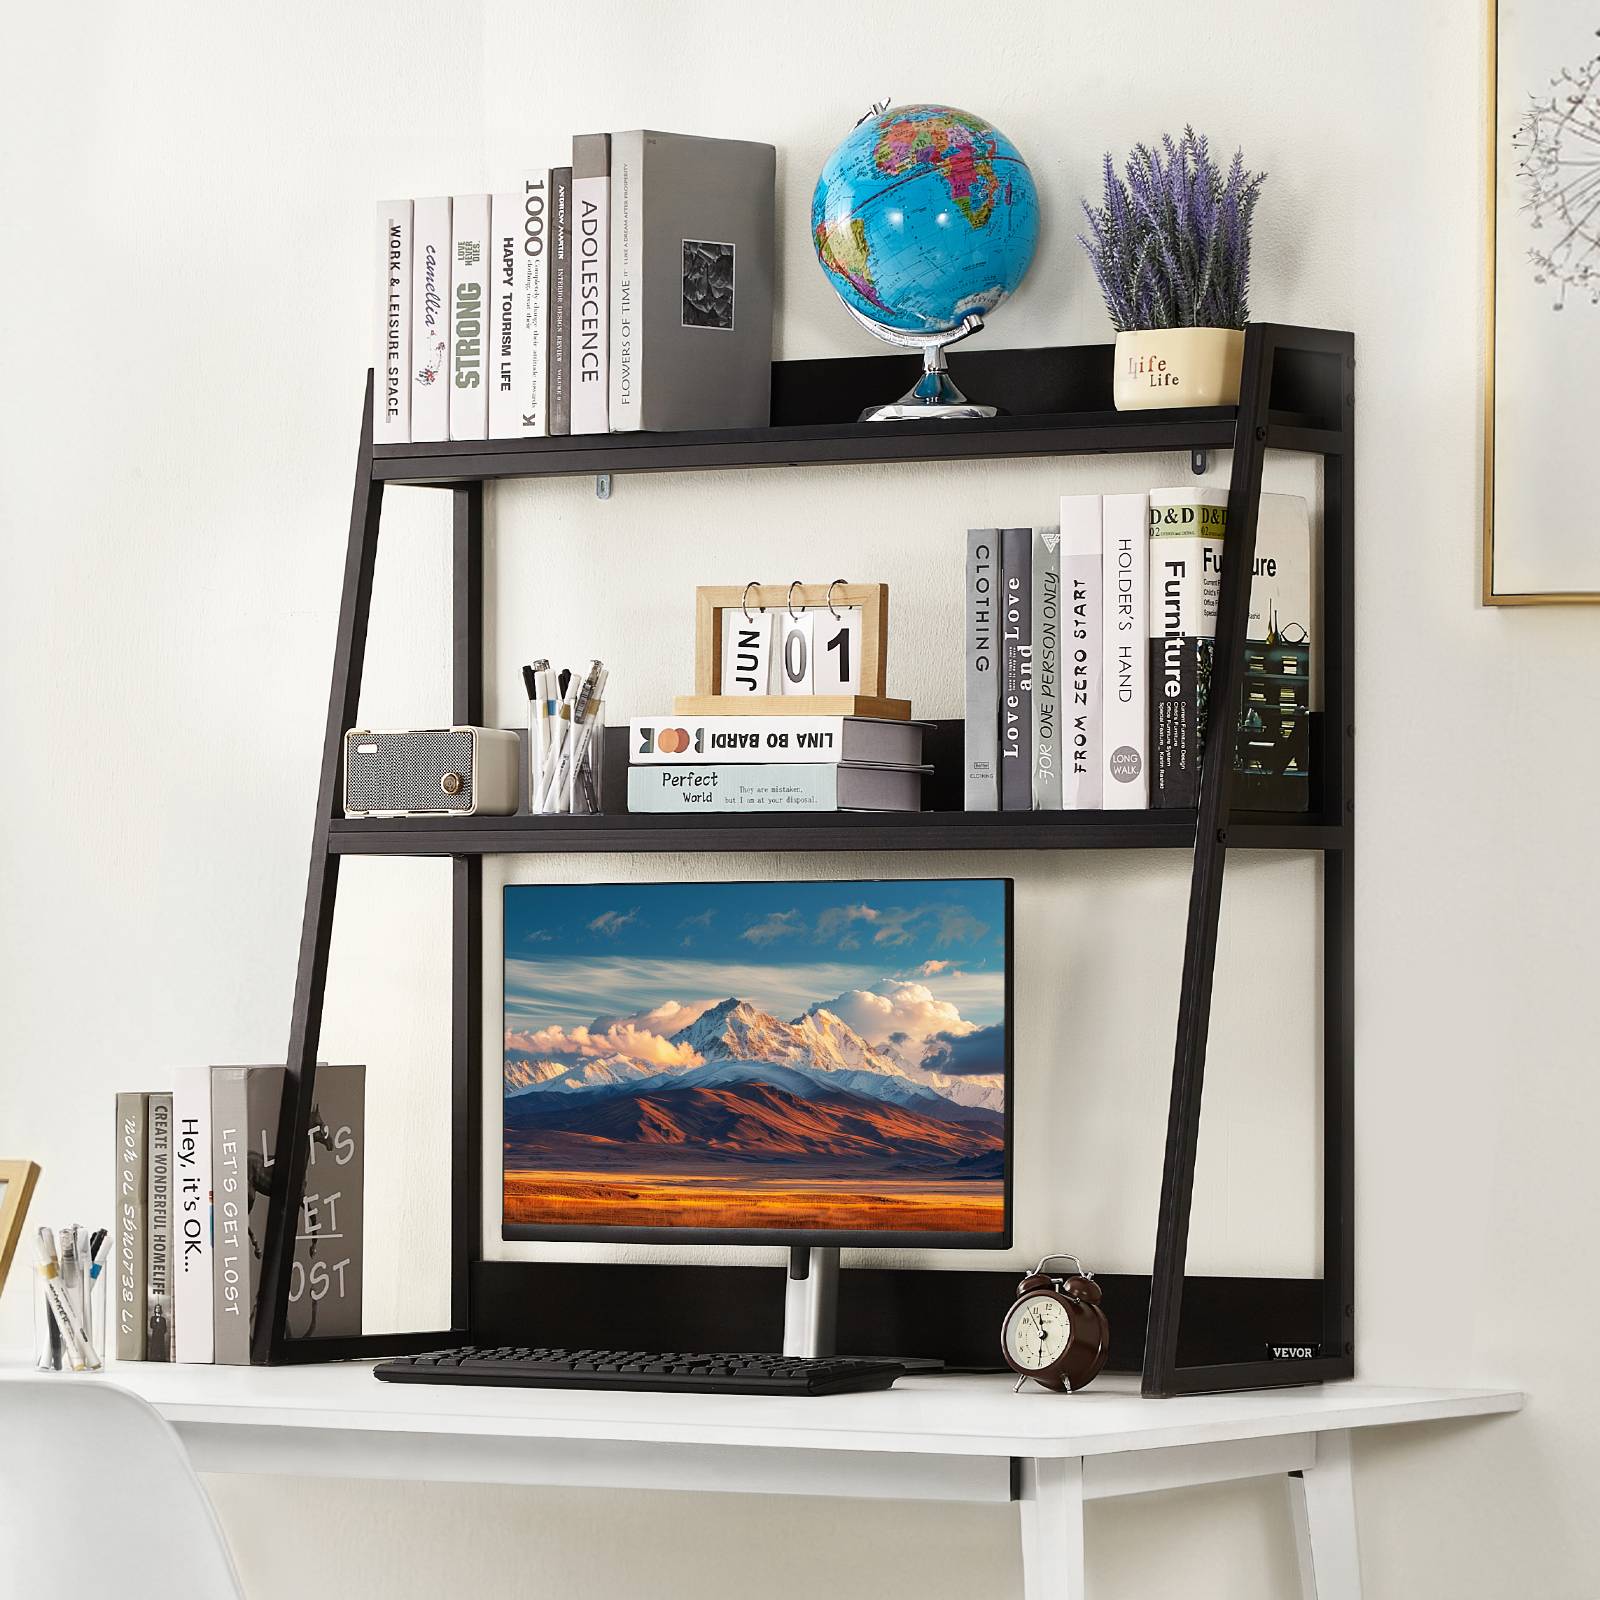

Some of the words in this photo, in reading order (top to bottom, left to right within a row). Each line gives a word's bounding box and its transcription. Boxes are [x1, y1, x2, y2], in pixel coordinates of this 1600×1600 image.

[525, 180, 544, 256] 1000
[390, 226, 400, 270] WORK
[503, 237, 513, 286] HAPPY
[390, 278, 399, 286] &
[425, 245, 440, 327] camellia
[581, 200, 599, 383] ADOLESCENCE
[622, 280, 630, 313] TIME
[389, 295, 399, 360] LEISURE
[456, 283, 481, 388] STRONG
[501, 293, 512, 357] TOURISM
[622, 319, 630, 337] OF
[388, 367, 398, 416] SPACE
[501, 362, 511, 391] LIFE
[622, 341, 630, 405] FLOWERS
[1150, 374, 1179, 387] Life
[523, 414, 535, 427] K
[976, 545, 989, 672] CLOTHING
[1005, 577, 1019, 640] Love
[1074, 580, 1087, 639] START
[1118, 539, 1133, 631] HOLDER'S
[1164, 560, 1185, 698] Furniture
[736, 630, 760, 691] JUN
[1018, 645, 1032, 691] and
[1040, 623, 1056, 698] PERSON
[1074, 649, 1087, 706] ZERO
[1118, 646, 1132, 703] HAND
[712, 734, 760, 748] BARDI
[766, 734, 789, 748] BO
[796, 732, 833, 748] LINA
[1004, 696, 1019, 757] Love
[1040, 703, 1053, 738] ONE
[1074, 716, 1087, 774] FROM
[662, 772, 718, 787] Perfect
[1113, 755, 1138, 763] LONG
[683, 792, 713, 803] World
[153, 1106, 168, 1149] CREATE
[178, 1118, 199, 1168] Hey,
[261, 1126, 355, 1168] LT'S
[123, 1170, 134, 1195] TO
[222, 1128, 237, 1193] LET'S
[153, 1154, 168, 1229] WONDERFUL
[303, 1192, 343, 1231] ET
[184, 1219, 202, 1272] OK...
[224, 1202, 238, 1248] GET
[122, 1204, 137, 1302] BELONGS
[152, 1234, 167, 1295] HOMELIFE
[224, 1257, 239, 1316] LOST
[288, 1258, 351, 1302] OST
[122, 1309, 133, 1334] IT
[1273, 1347, 1312, 1359] VEVOR
